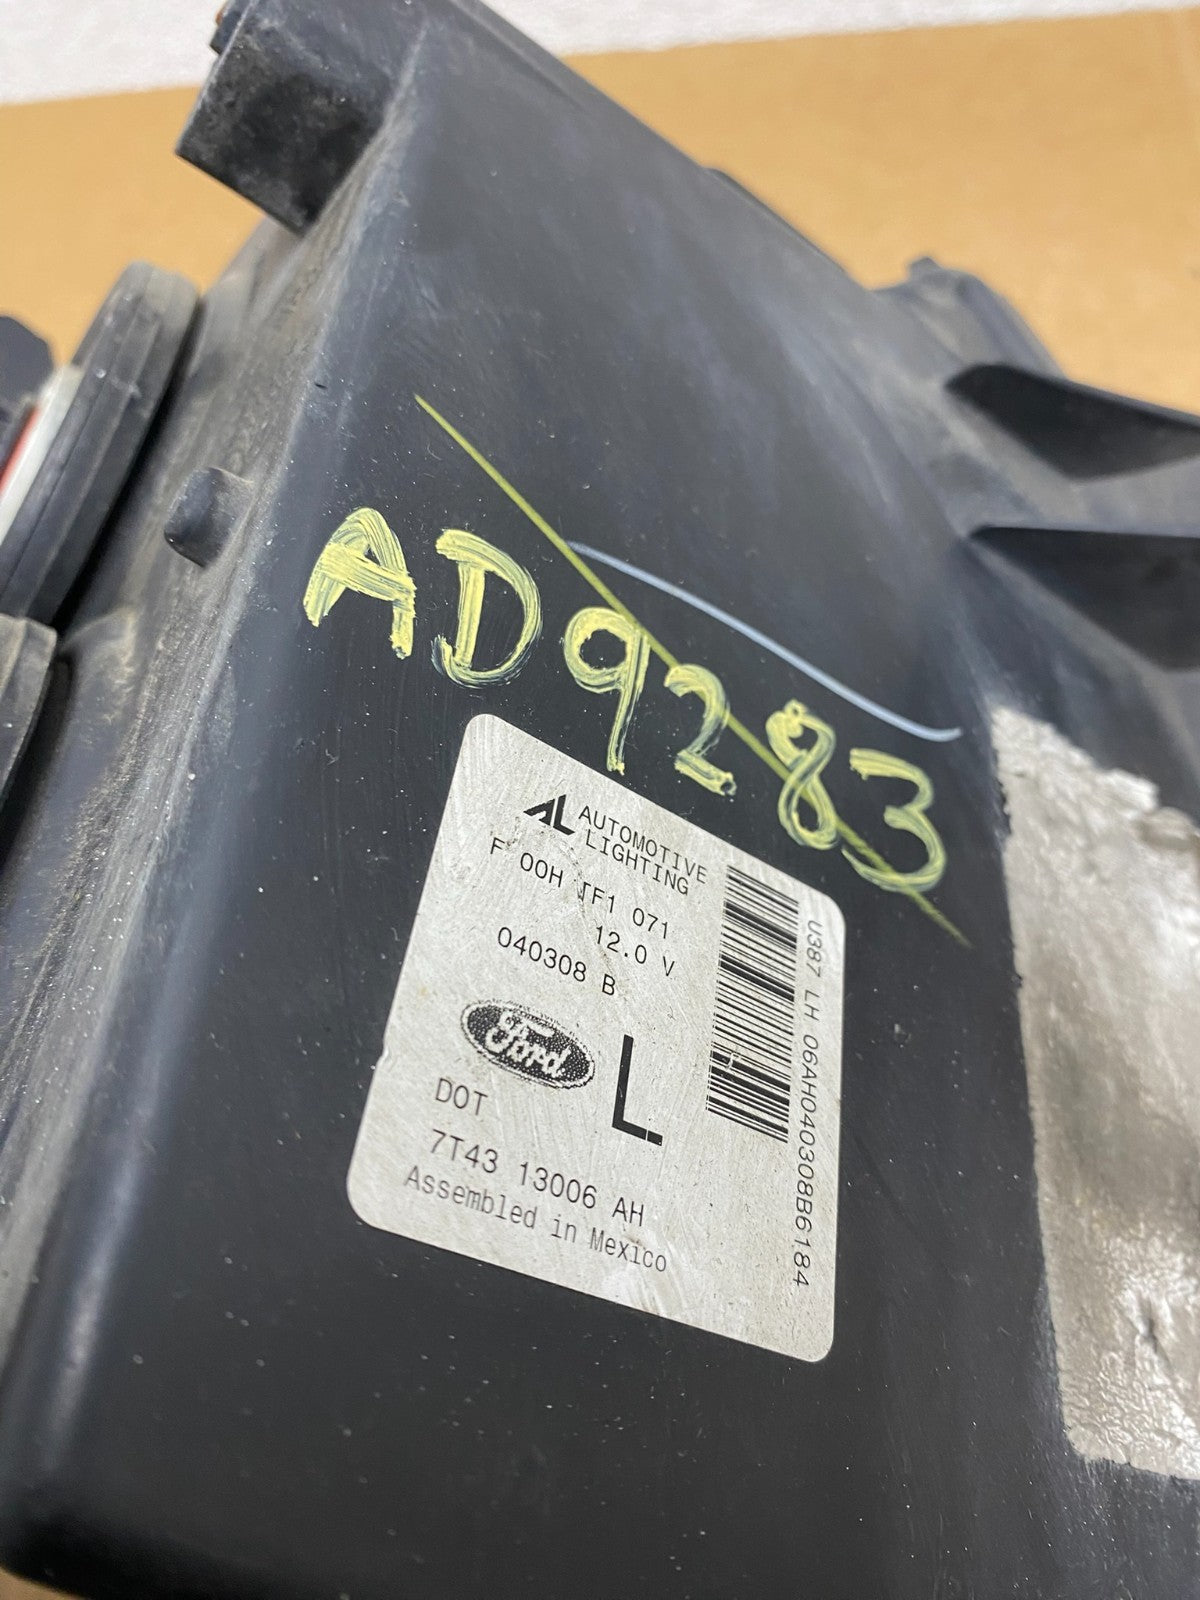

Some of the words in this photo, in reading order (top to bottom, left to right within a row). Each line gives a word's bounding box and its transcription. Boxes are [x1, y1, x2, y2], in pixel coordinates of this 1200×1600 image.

[578, 805, 708, 884] AUTOMOTIVE
[585, 828, 689, 896] LIGHTING
[490, 836, 505, 855] F
[632, 907, 668, 940] 071
[497, 926, 587, 983] 040308
[601, 973, 616, 996] B
[596, 925, 647, 965] 12.0
[662, 955, 676, 977] V
[806, 919, 823, 978] U387
[804, 988, 820, 1022] LH
[434, 1077, 489, 1116] DOT
[611, 1033, 664, 1147] L
[430, 1128, 499, 1174] 7T43
[519, 1161, 597, 1209] 13006
[611, 1196, 645, 1228] AH
[792, 1033, 819, 1288] 06AH040308B6184
[402, 1164, 539, 1230] Assembled
[549, 1213, 577, 1243] in
[589, 1226, 668, 1273] Mexico
